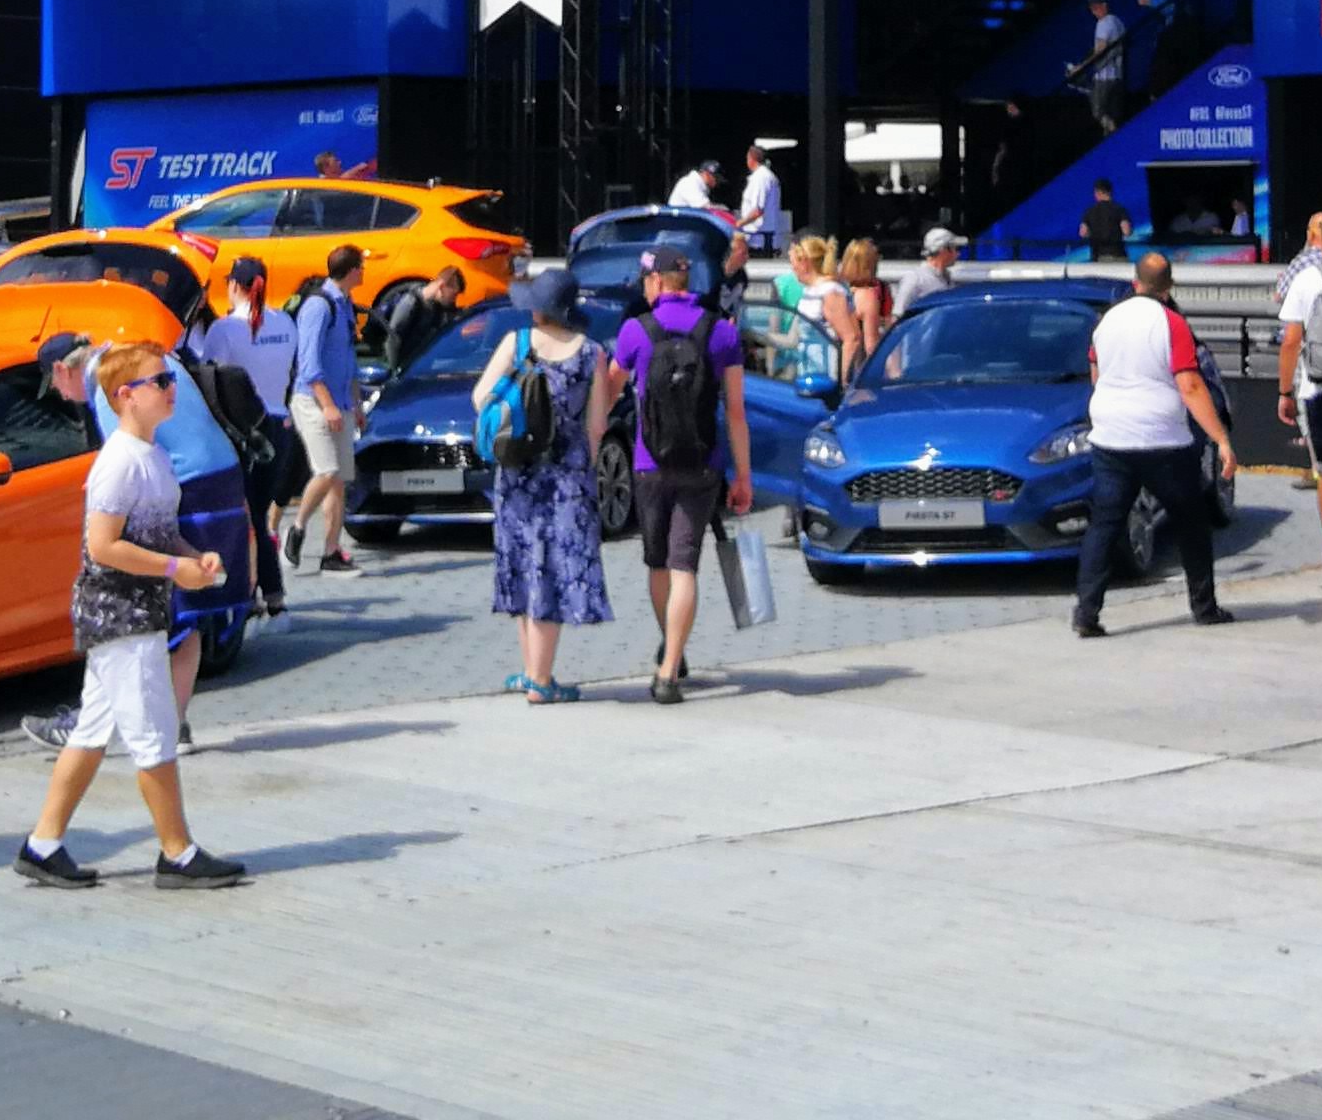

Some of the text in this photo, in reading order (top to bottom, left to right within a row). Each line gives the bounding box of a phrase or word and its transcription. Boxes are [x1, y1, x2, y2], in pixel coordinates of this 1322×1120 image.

[1160, 125, 1253, 150] PHOTO COLLECTION
[105, 147, 278, 189] ST TEST TRACK
